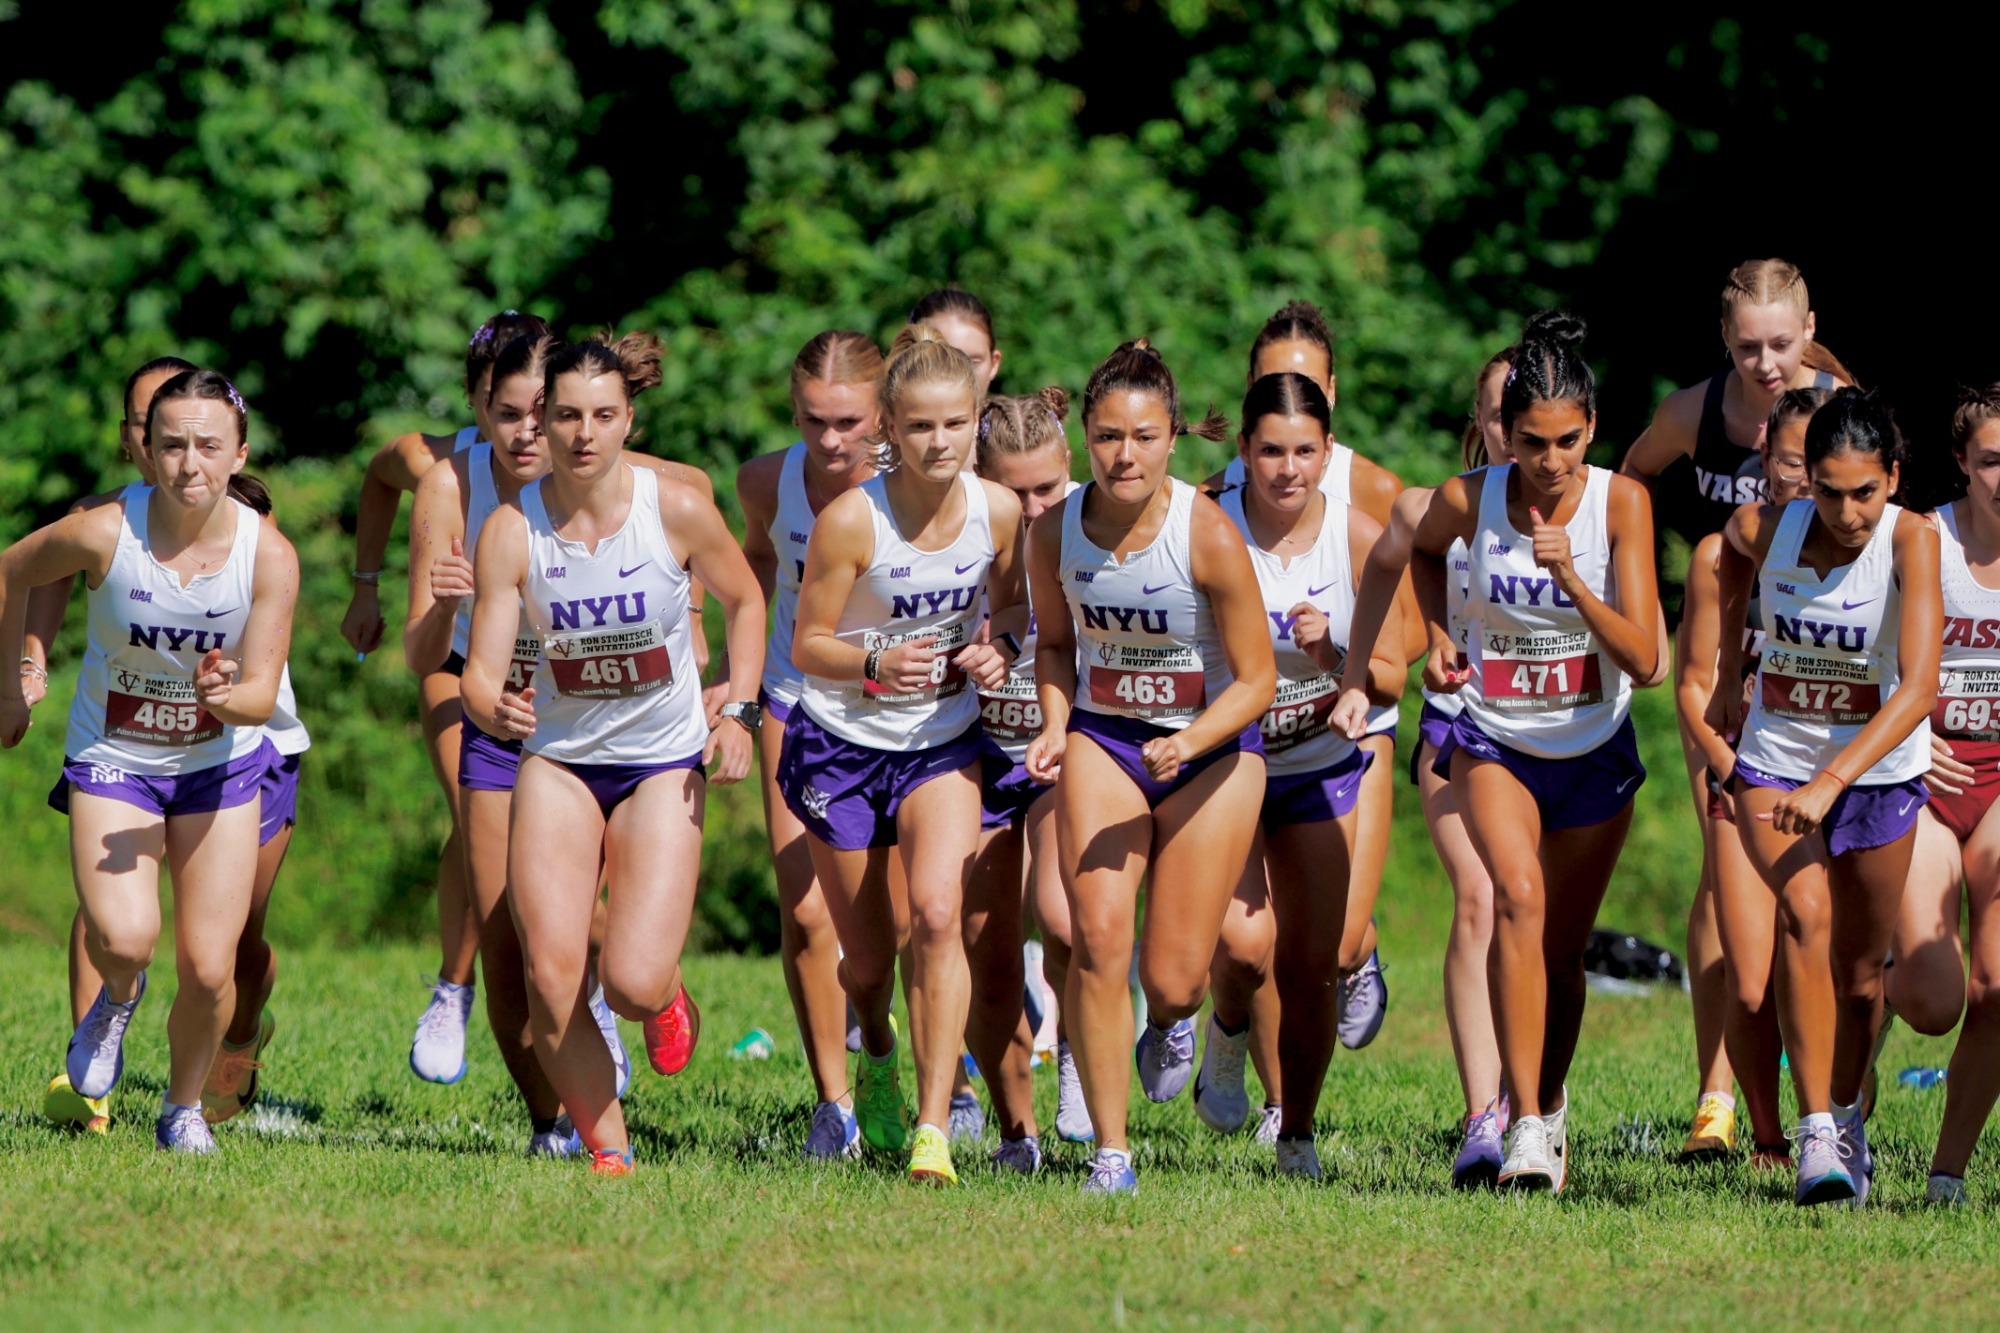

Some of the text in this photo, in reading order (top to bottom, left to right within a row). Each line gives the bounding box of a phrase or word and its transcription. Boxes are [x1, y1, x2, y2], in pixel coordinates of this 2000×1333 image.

[546, 567, 566, 578] UAA
[890, 566, 911, 578] UAA
[1075, 570, 1094, 583] UAA
[129, 588, 153, 603] UAA
[890, 585, 978, 619] NYU
[550, 591, 646, 631] NYU
[1080, 603, 1168, 634] NYU
[129, 622, 226, 654] NYU
[580, 628, 653, 646] RON STONITSCH
[1515, 632, 1586, 646] RON STONITSCH
[1774, 613, 1867, 652] NYU
[581, 637, 655, 653] INVITATIONAL
[1121, 646, 1192, 658] RON STONITSCH
[1516, 642, 1587, 656] INVITATIONAL
[580, 656, 639, 684] 461
[1120, 657, 1193, 667] INVITATIONAL
[1795, 656, 1869, 672] RON STONITSCH
[1511, 662, 1568, 694] 471
[1795, 666, 1869, 680] INVITATIONAL
[1964, 671, 1984, 681] RON
[144, 679, 165, 689] RON
[1115, 674, 1176, 704] 463
[1789, 681, 1851, 710] 472
[134, 701, 197, 732] 465
[982, 701, 1043, 728] 469
[1259, 703, 1315, 738] 462
